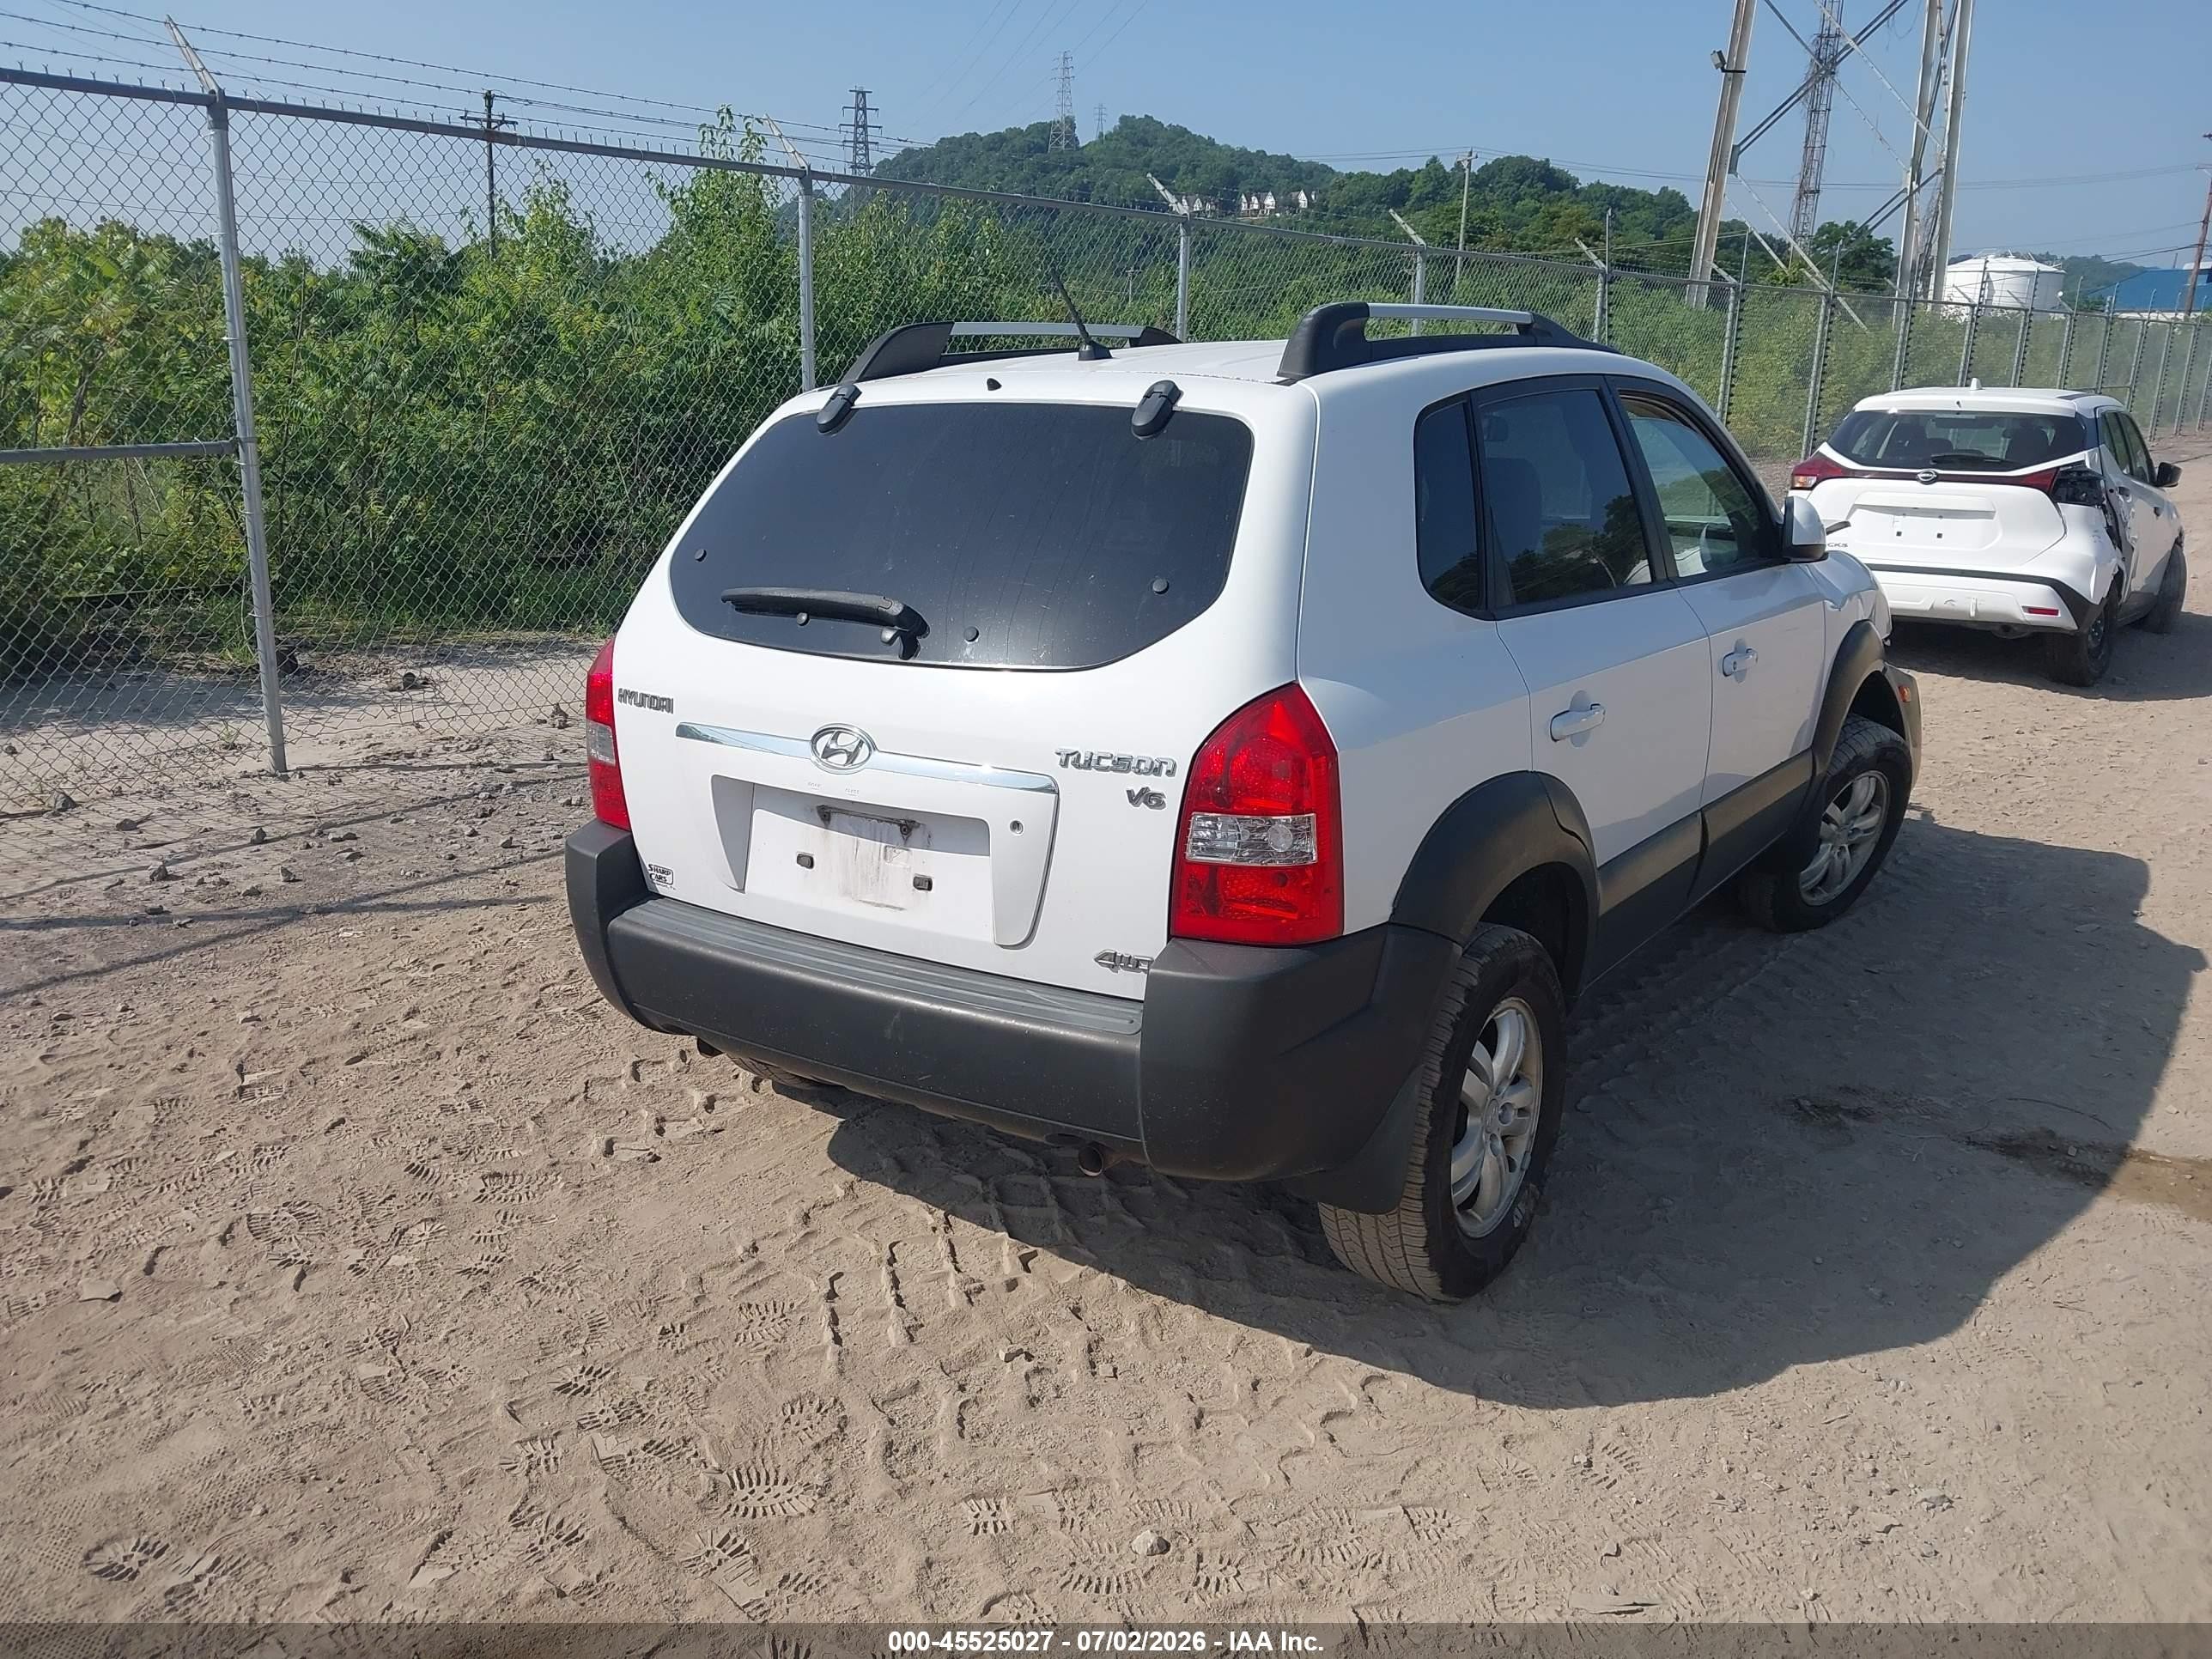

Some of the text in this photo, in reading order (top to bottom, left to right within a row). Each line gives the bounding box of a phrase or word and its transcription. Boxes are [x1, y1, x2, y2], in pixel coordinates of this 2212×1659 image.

[618, 688, 674, 714] HYUNDAI
[1055, 748, 1177, 777] TUCSON
[1126, 787, 1167, 810] V6
[648, 864, 672, 876] SHARP
[649, 872, 667, 882] CARS
